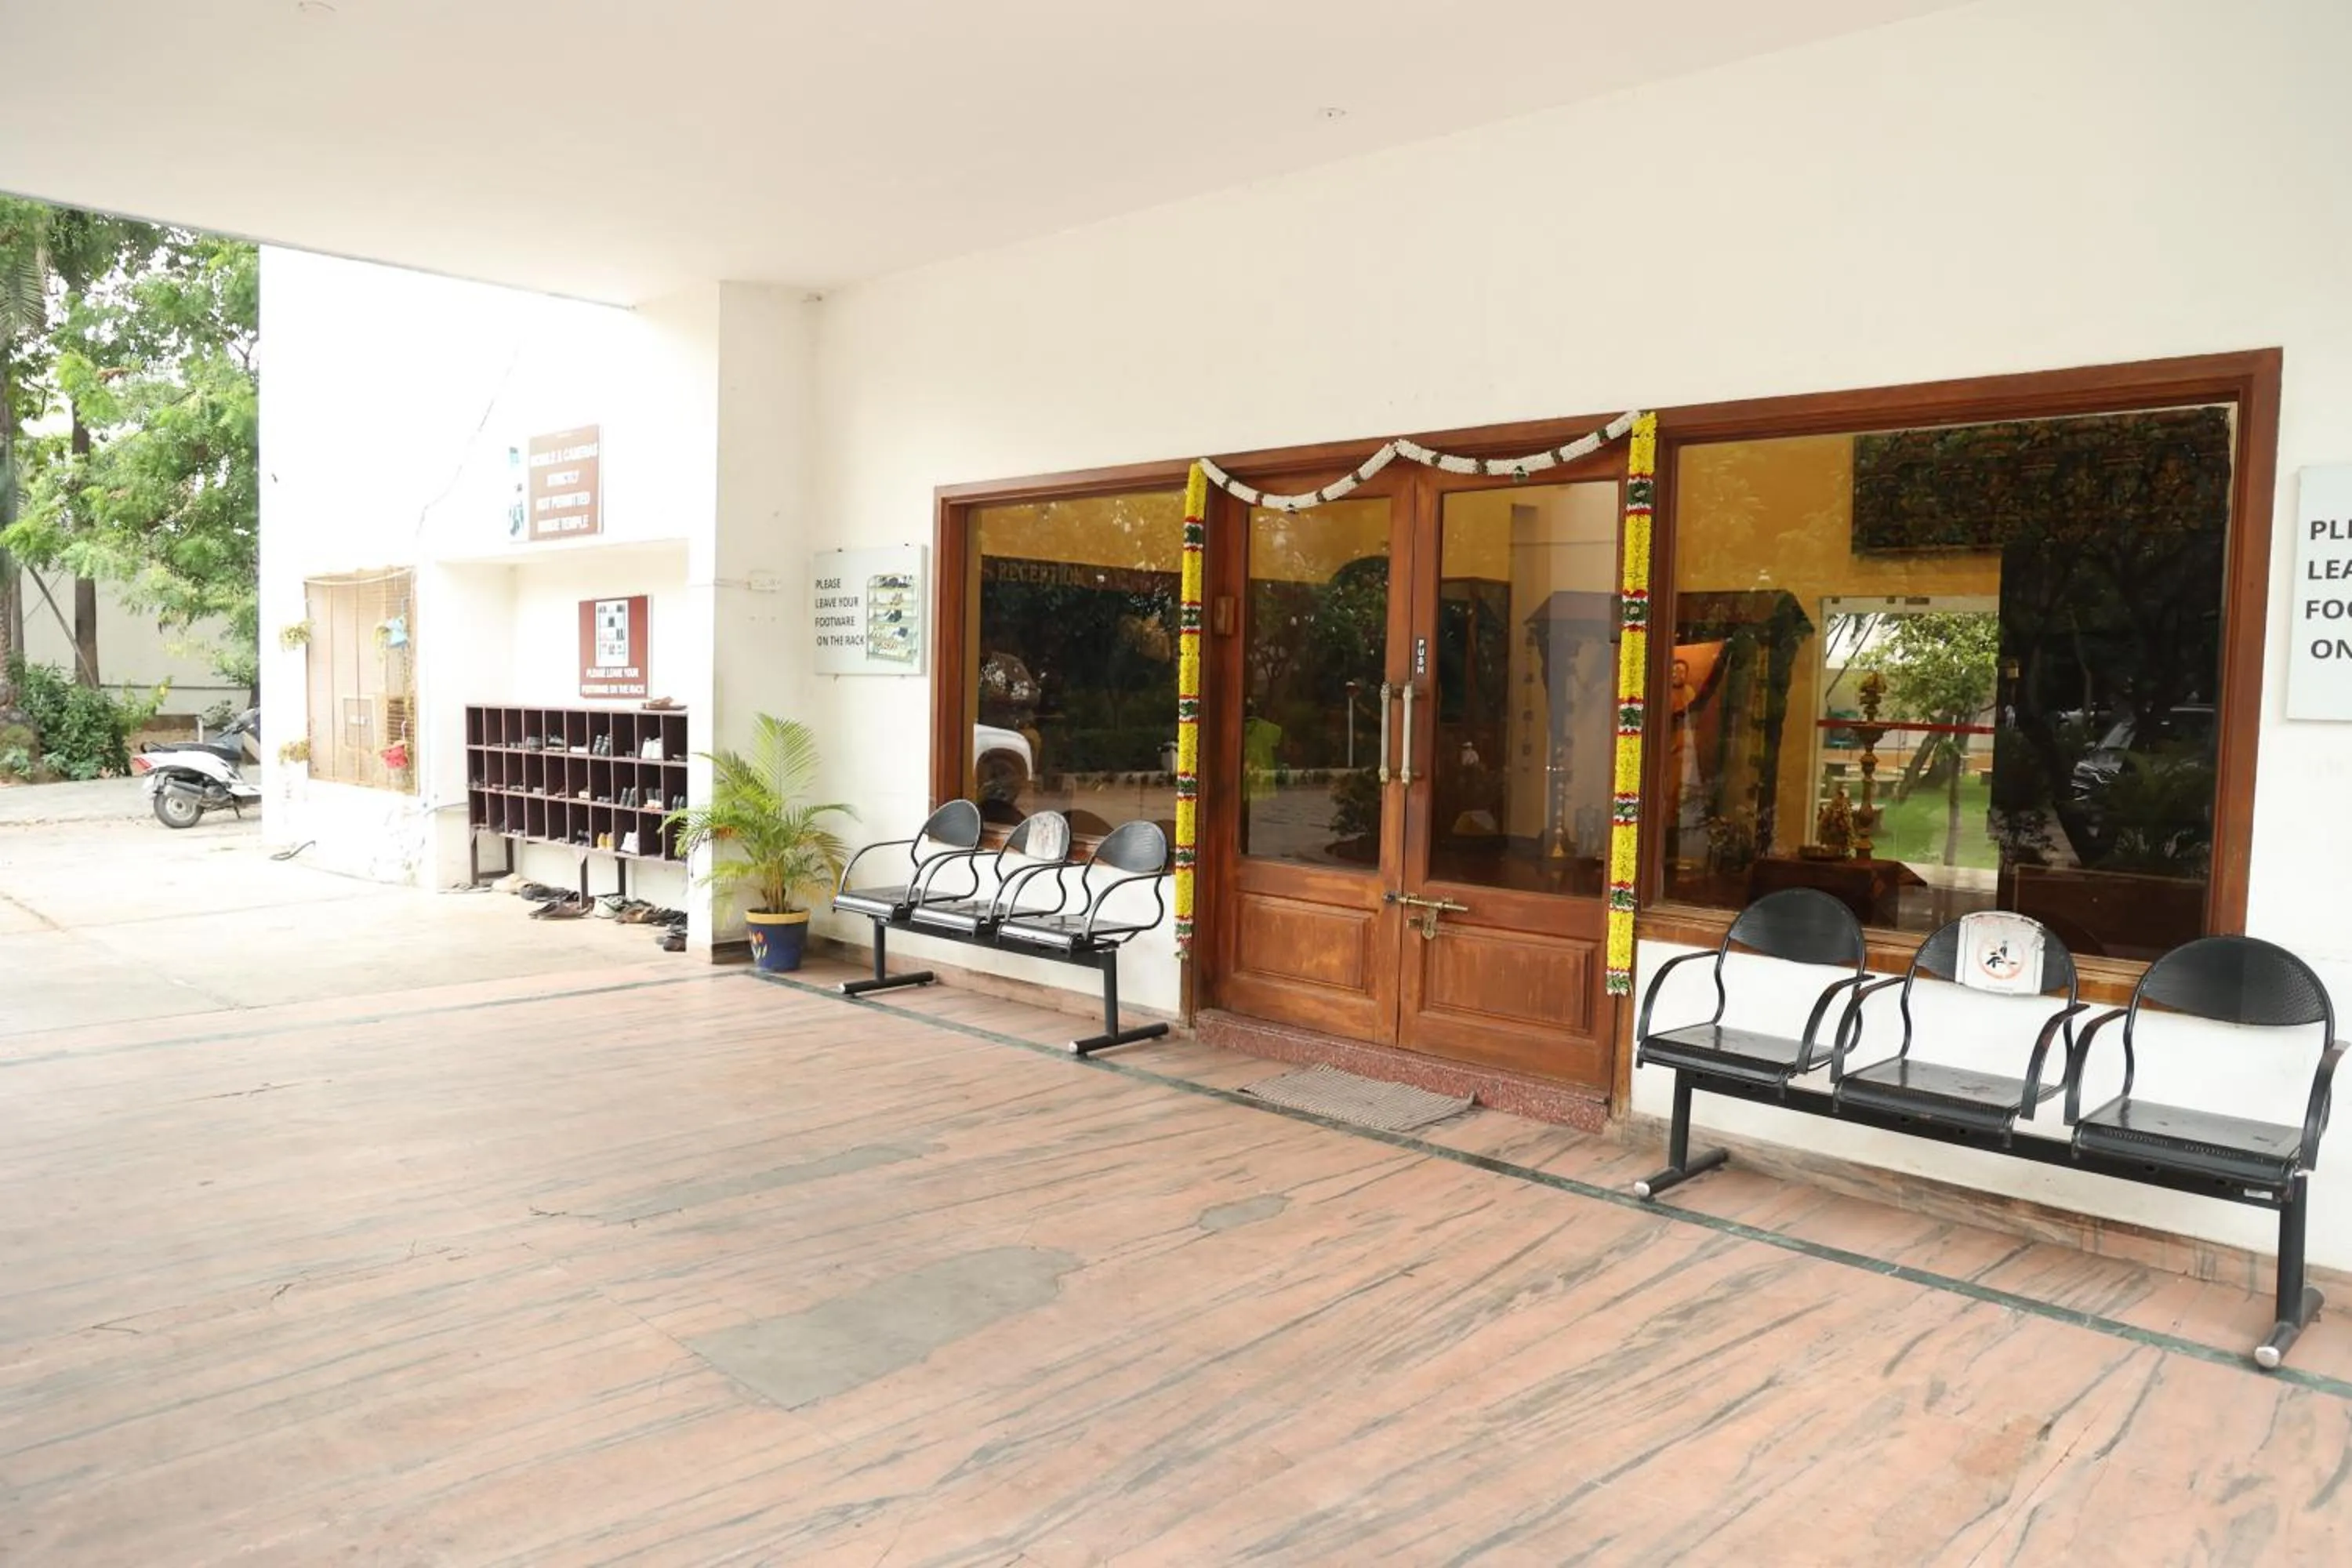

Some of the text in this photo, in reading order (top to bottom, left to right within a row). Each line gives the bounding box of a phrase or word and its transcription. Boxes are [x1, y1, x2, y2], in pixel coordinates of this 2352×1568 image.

[815, 578, 840, 590] PLEASE
[815, 596, 858, 608] LEAVE YOUR
[815, 615, 855, 627] FOOTWARE
[816, 634, 865, 646] ON THE RACK
[2311, 639, 2352, 659] ON
